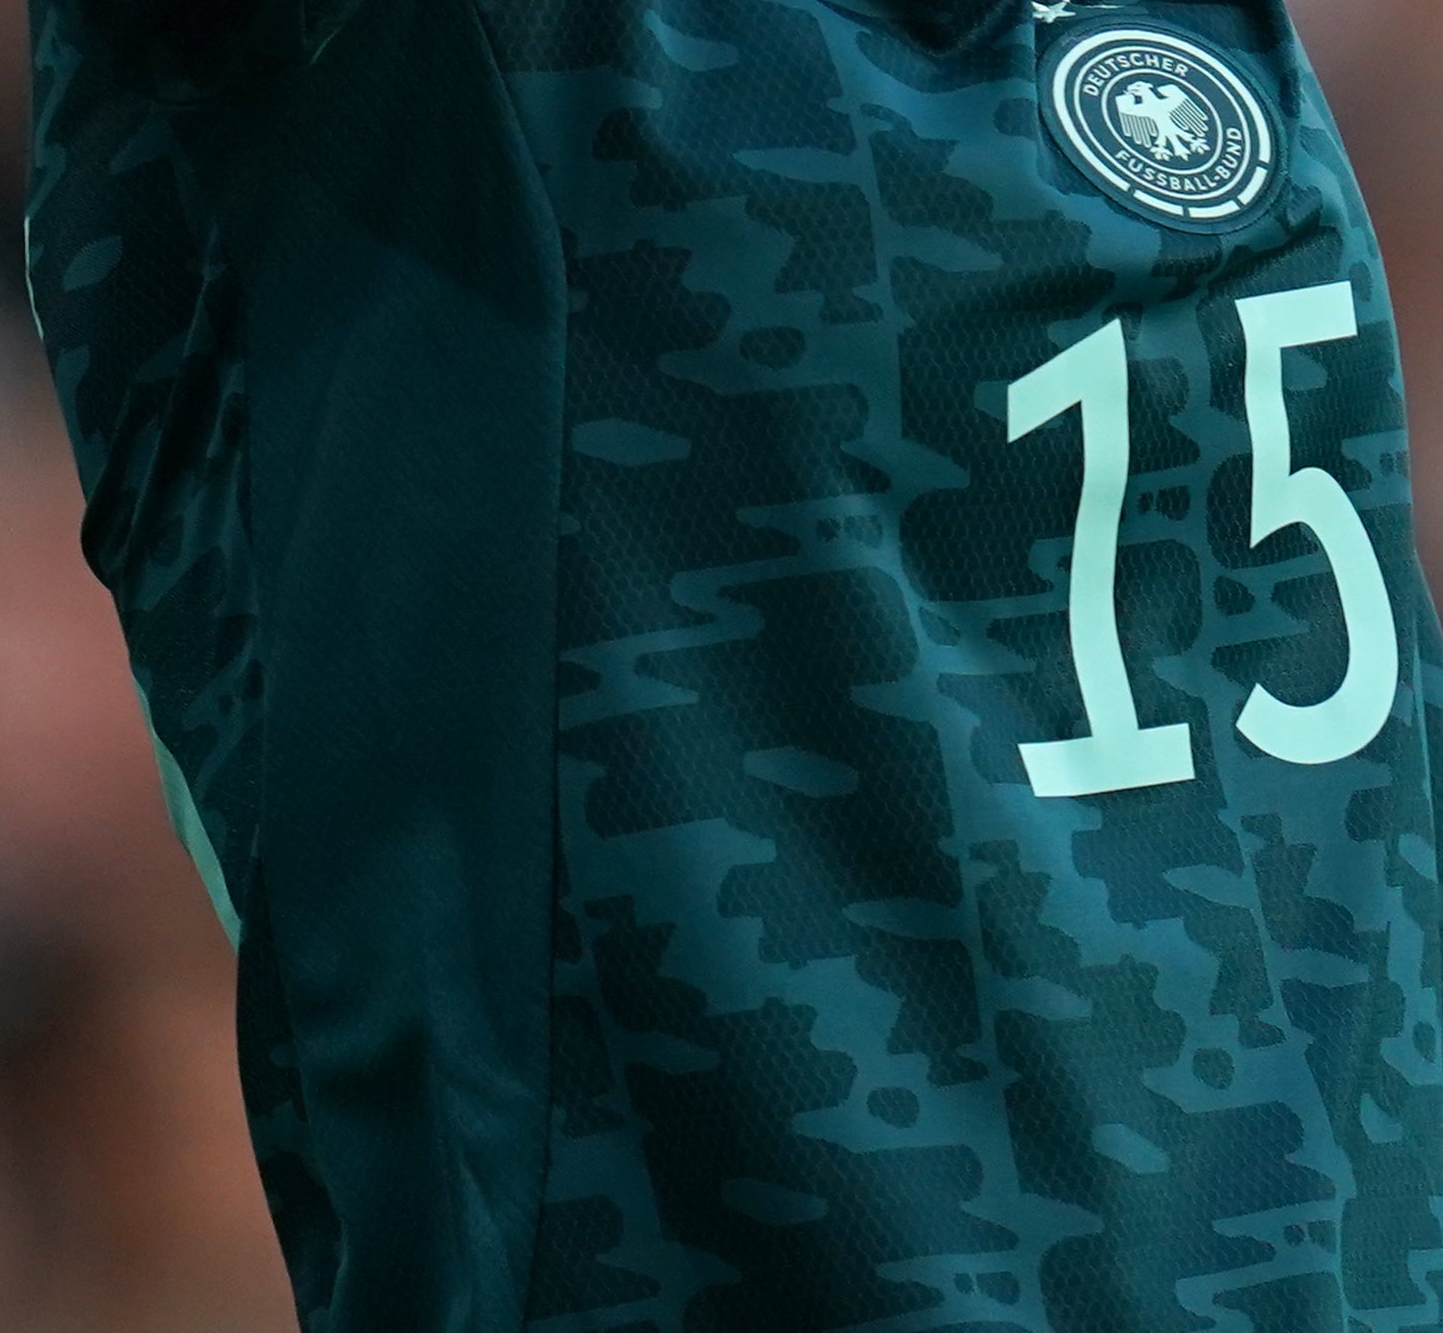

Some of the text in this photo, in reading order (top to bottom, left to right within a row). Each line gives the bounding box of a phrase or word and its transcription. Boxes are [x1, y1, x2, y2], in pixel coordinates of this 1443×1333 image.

[1083, 52, 1190, 97] DEUTSCHER
[1114, 126, 1243, 193] FUSSBALL-BUND
[1007, 280, 1399, 798] 15
